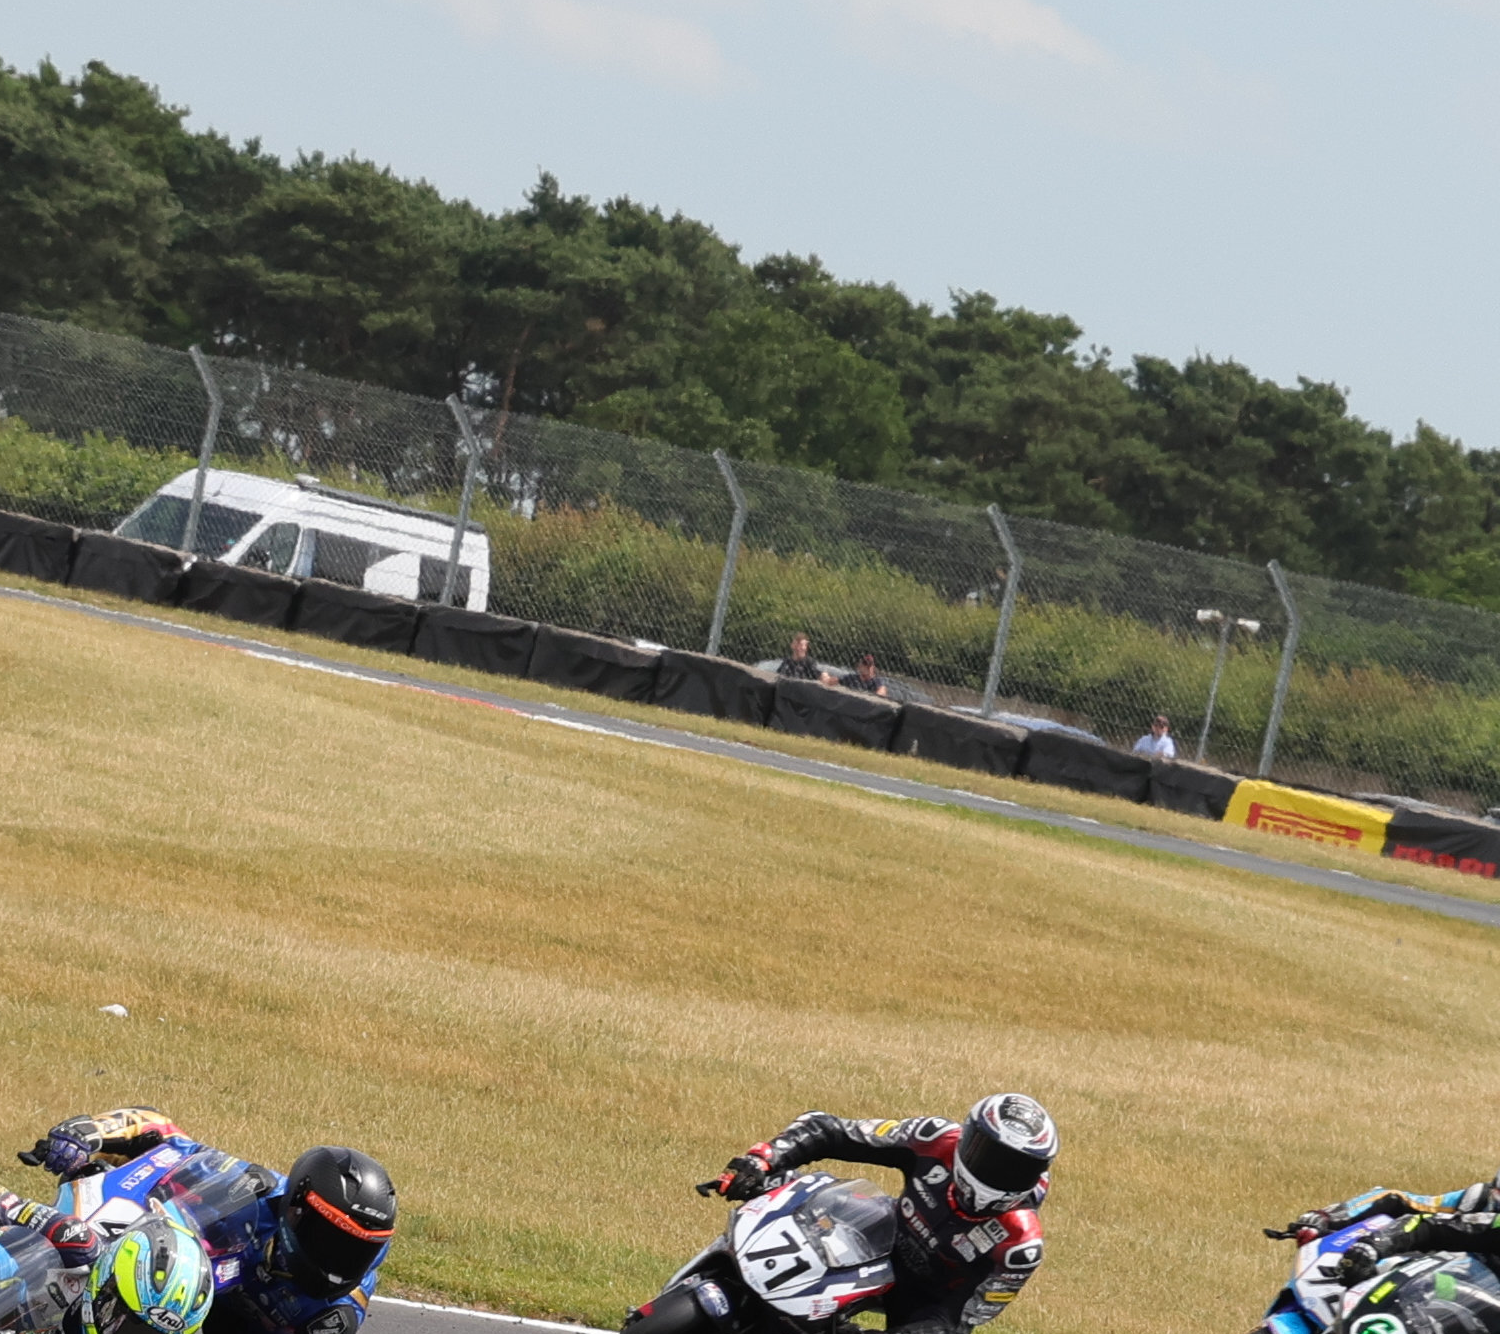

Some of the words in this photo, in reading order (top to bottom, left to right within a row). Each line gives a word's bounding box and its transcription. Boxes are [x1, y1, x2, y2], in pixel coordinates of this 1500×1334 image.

[351, 1203, 388, 1220] LS2
[745, 1230, 812, 1291] 71
[153, 1308, 184, 1330] Arai
